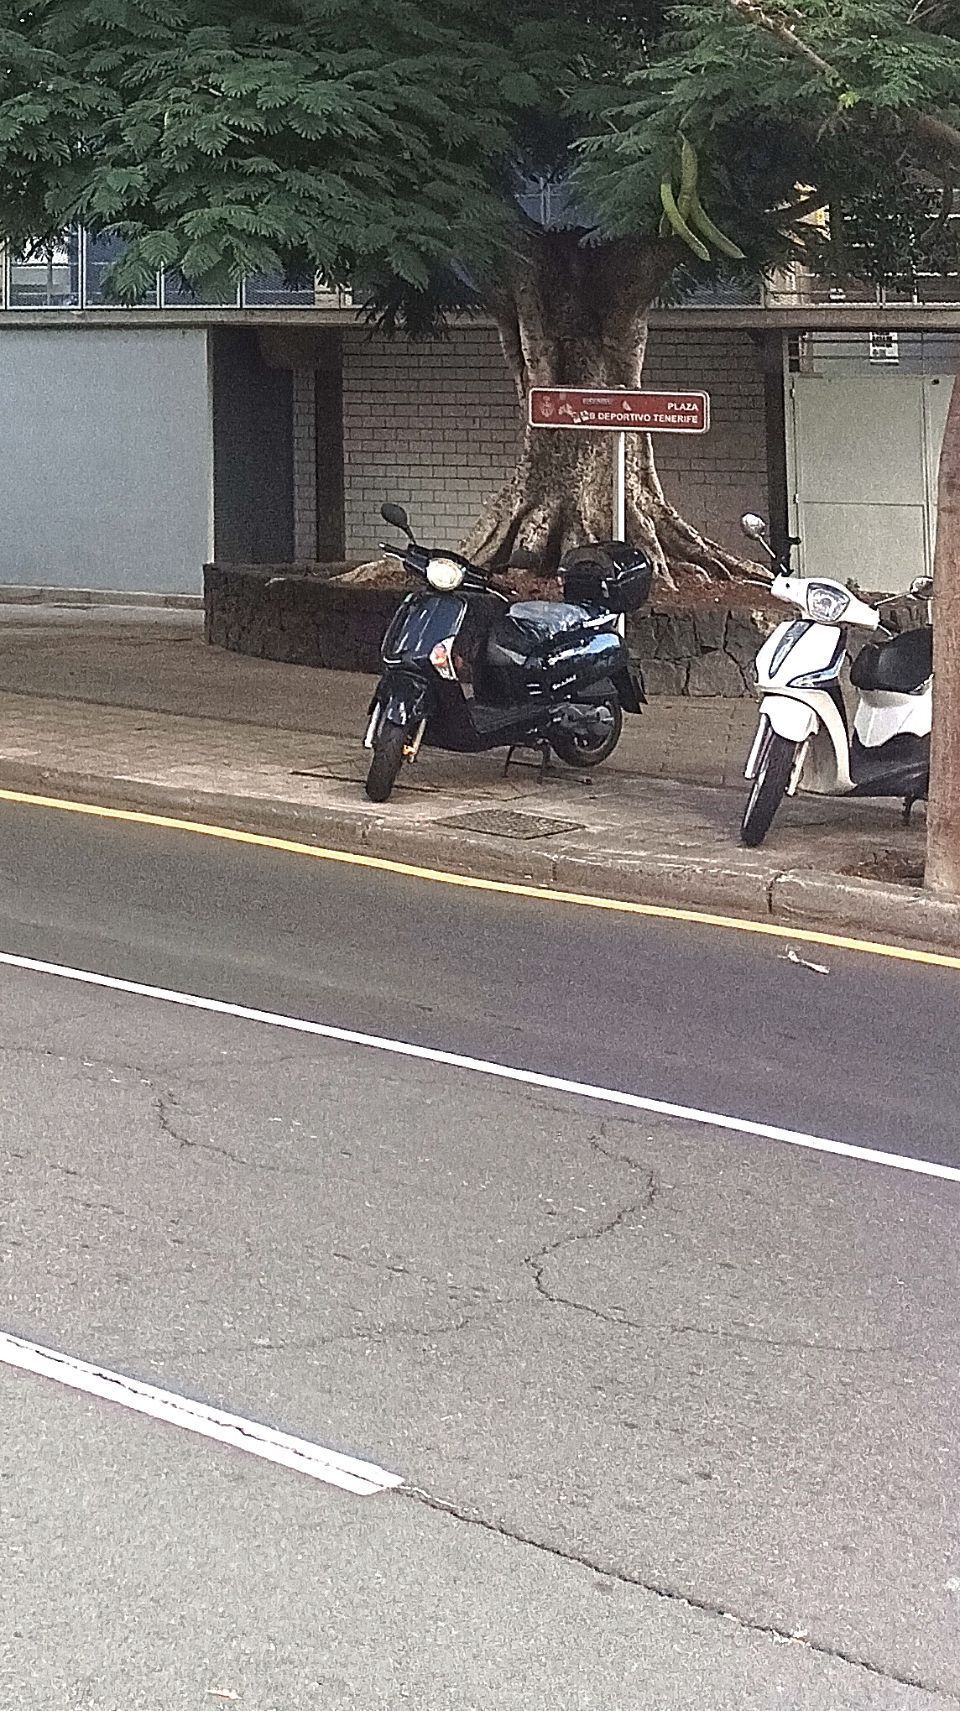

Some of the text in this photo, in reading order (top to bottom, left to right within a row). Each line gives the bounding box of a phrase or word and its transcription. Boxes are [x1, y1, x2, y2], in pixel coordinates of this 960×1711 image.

[667, 402, 699, 412] PLAZA
[597, 412, 651, 422] DEPORTIVO
[653, 414, 699, 423] TENERIFE
